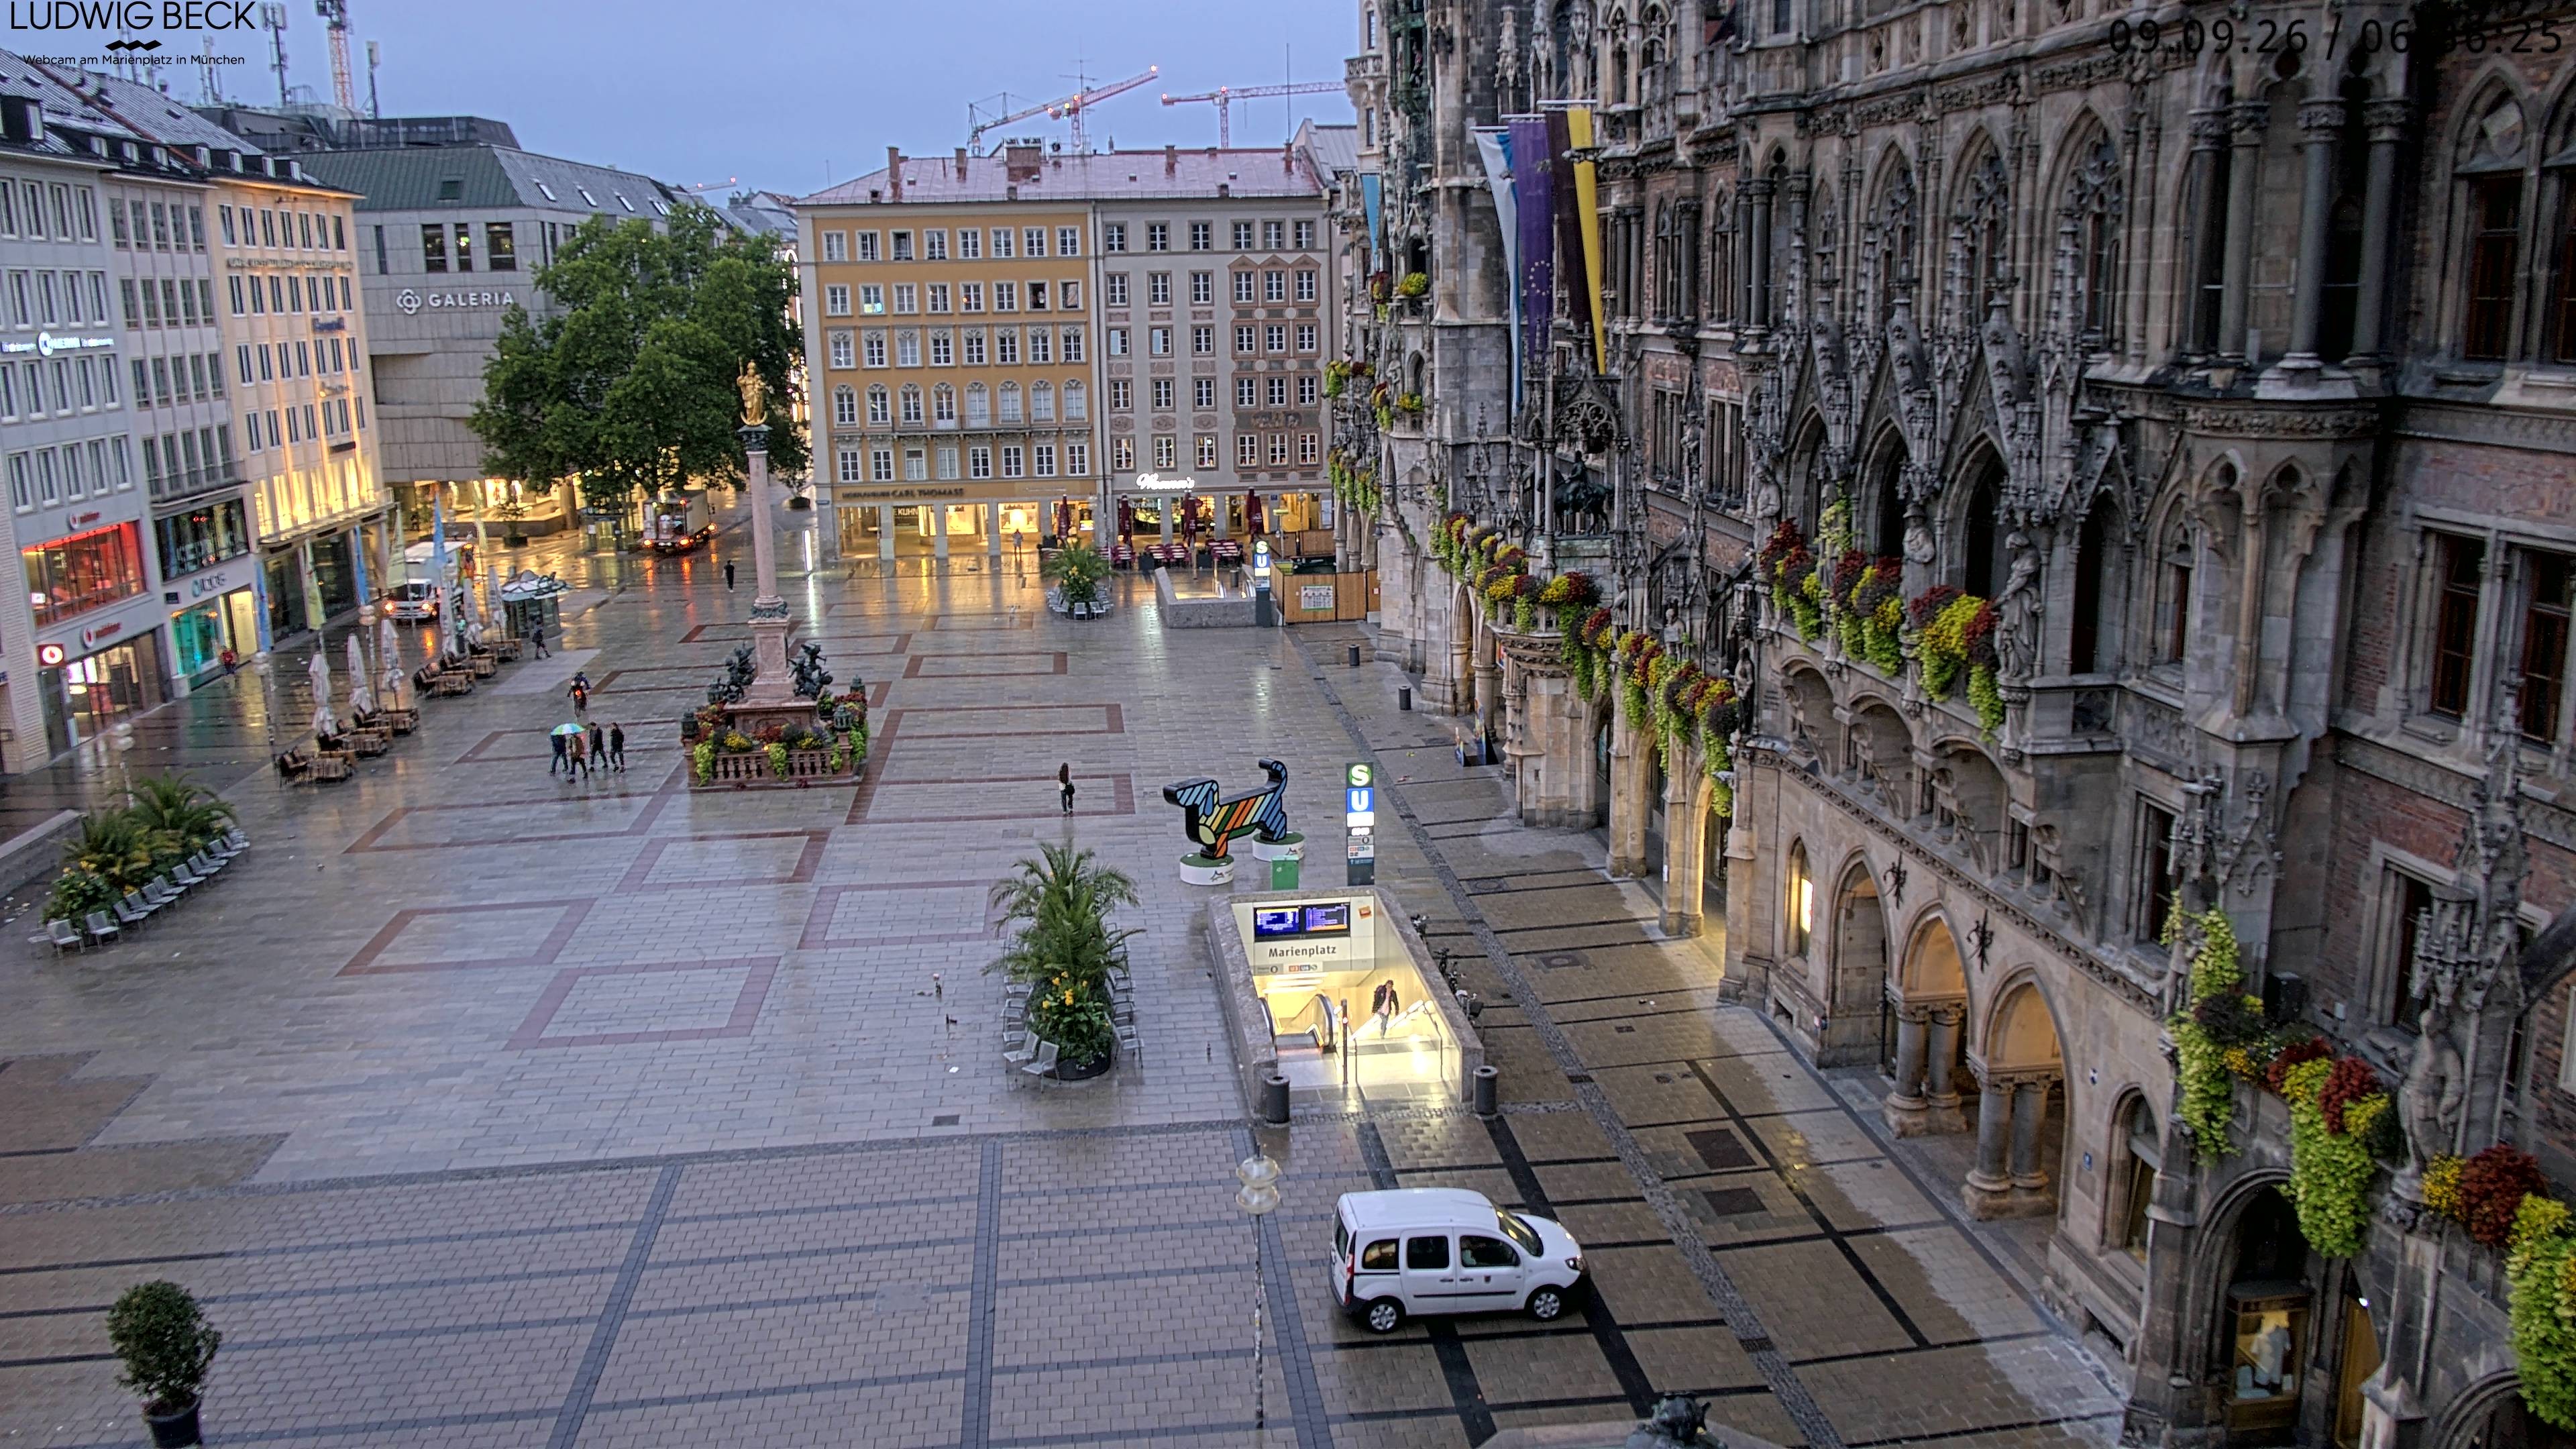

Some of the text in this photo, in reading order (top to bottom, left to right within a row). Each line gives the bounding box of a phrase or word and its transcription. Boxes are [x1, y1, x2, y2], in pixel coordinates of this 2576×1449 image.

[429, 291, 515, 307] GALERIA
[1256, 541, 1268, 554] S
[1256, 555, 1267, 568] U
[1350, 764, 1370, 786] S
[1351, 790, 1369, 811] U
[1268, 945, 1337, 957] Marienplatz
